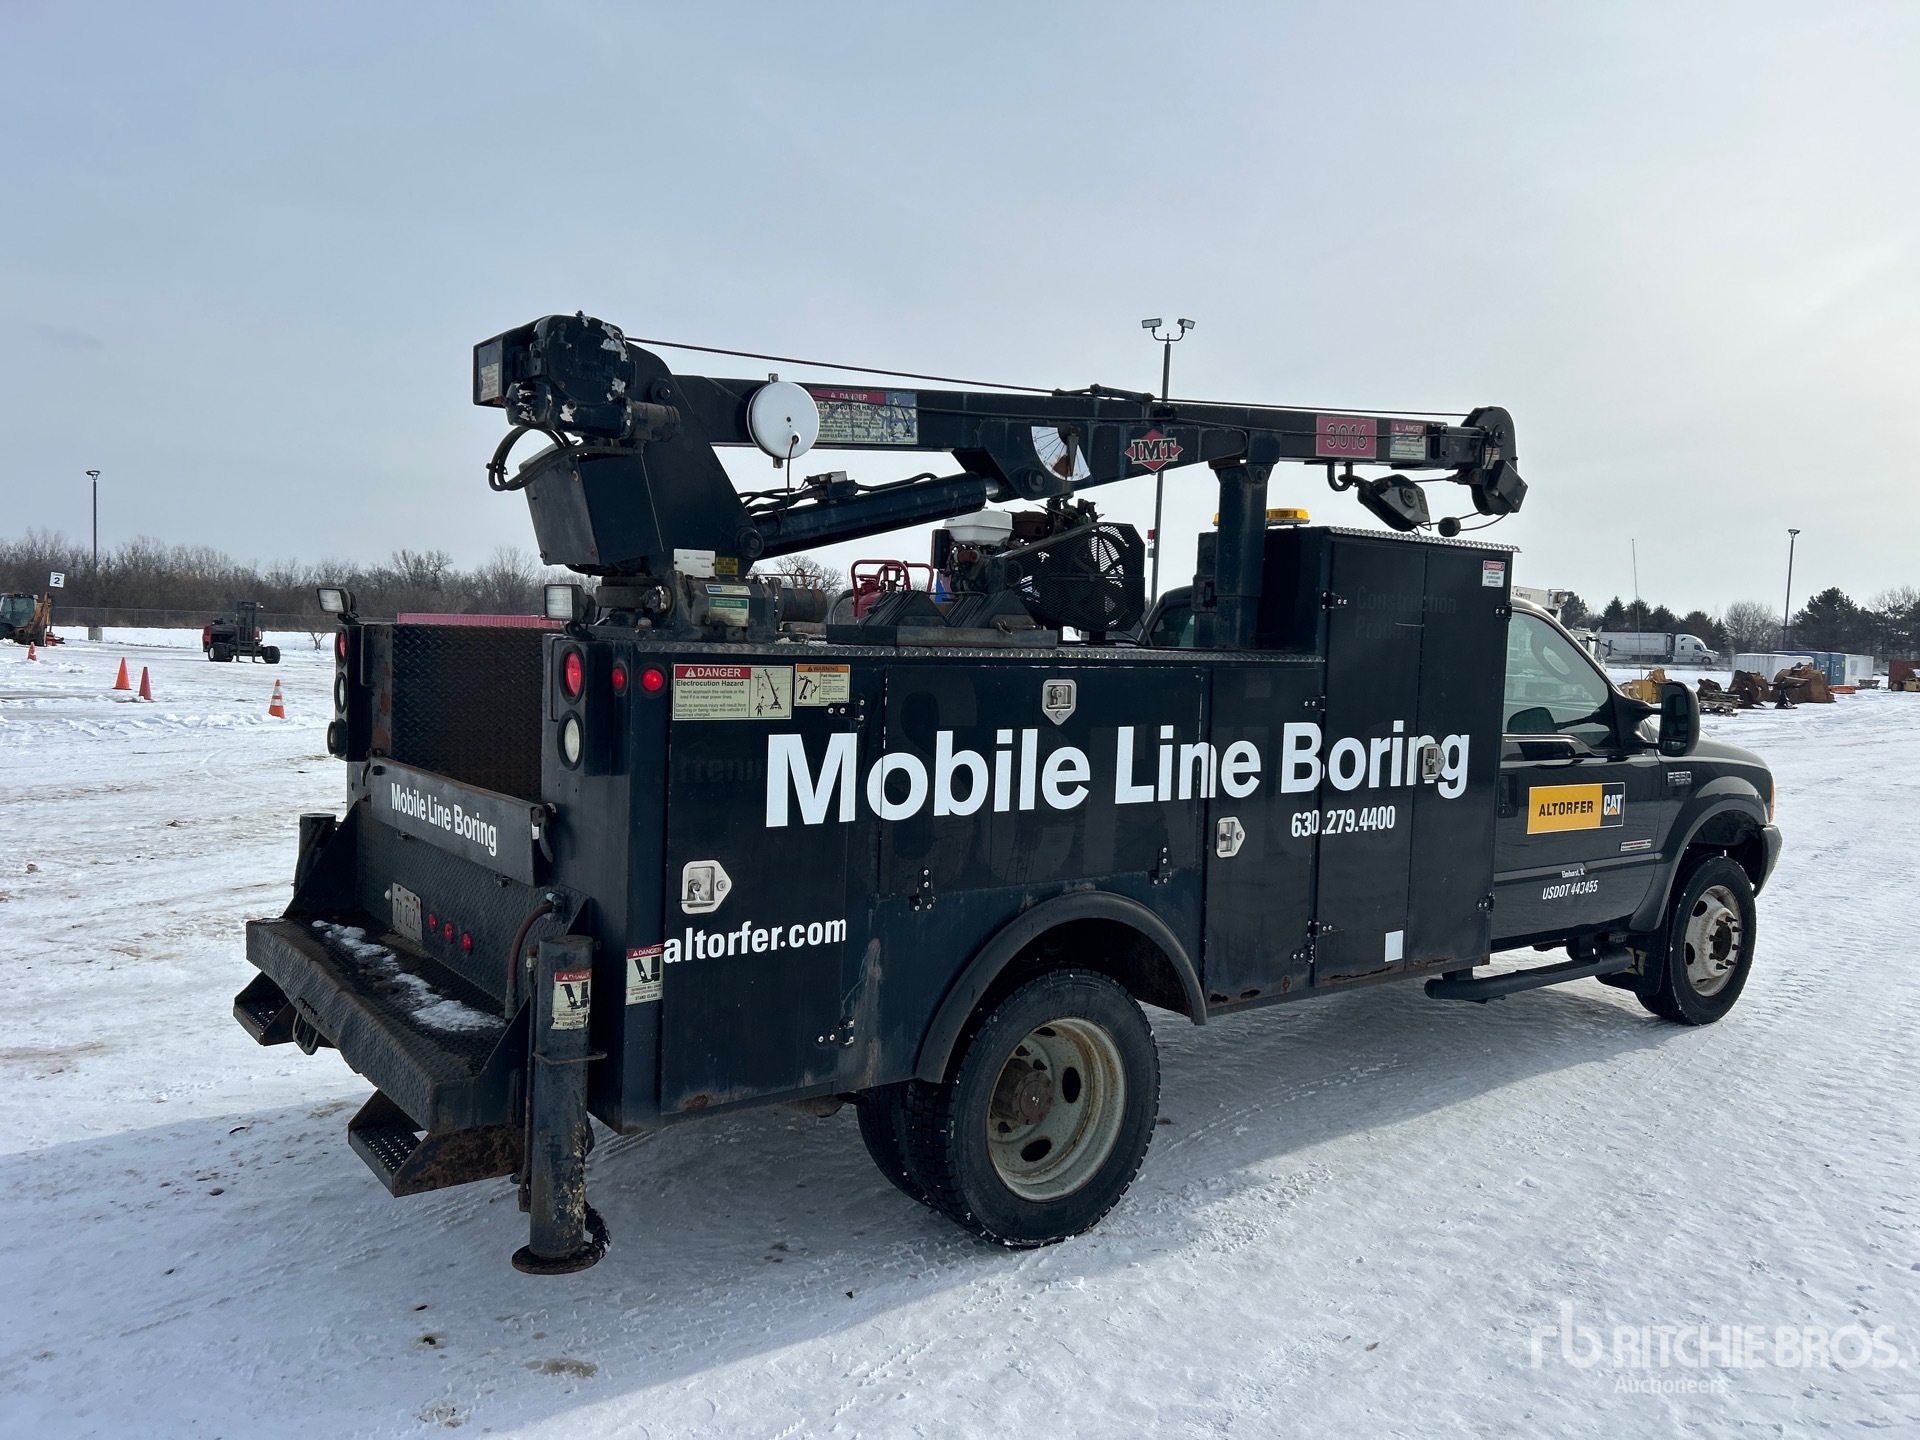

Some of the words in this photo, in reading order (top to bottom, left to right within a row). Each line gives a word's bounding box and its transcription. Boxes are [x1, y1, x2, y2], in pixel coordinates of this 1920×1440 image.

[816, 403, 861, 411] LECTROCUTION
[1326, 422, 1367, 450] 3016
[1131, 438, 1178, 463] IMT
[697, 667, 741, 677] DANGER
[766, 728, 1091, 828] Mobile
[1115, 725, 1262, 805] Line
[1280, 719, 1470, 799] Boring
[1538, 800, 1594, 817] ALTORFER
[1603, 794, 1624, 816] CAT
[391, 782, 427, 821] Mobile
[427, 794, 452, 831] Line
[453, 803, 497, 857] Boring
[1291, 805, 1396, 838] 630.279.4400
[1542, 882, 1571, 901] USDOT
[1570, 879, 1599, 895] 443455
[638, 947, 662, 956] DANGER
[663, 918, 847, 964] altorfer.com
